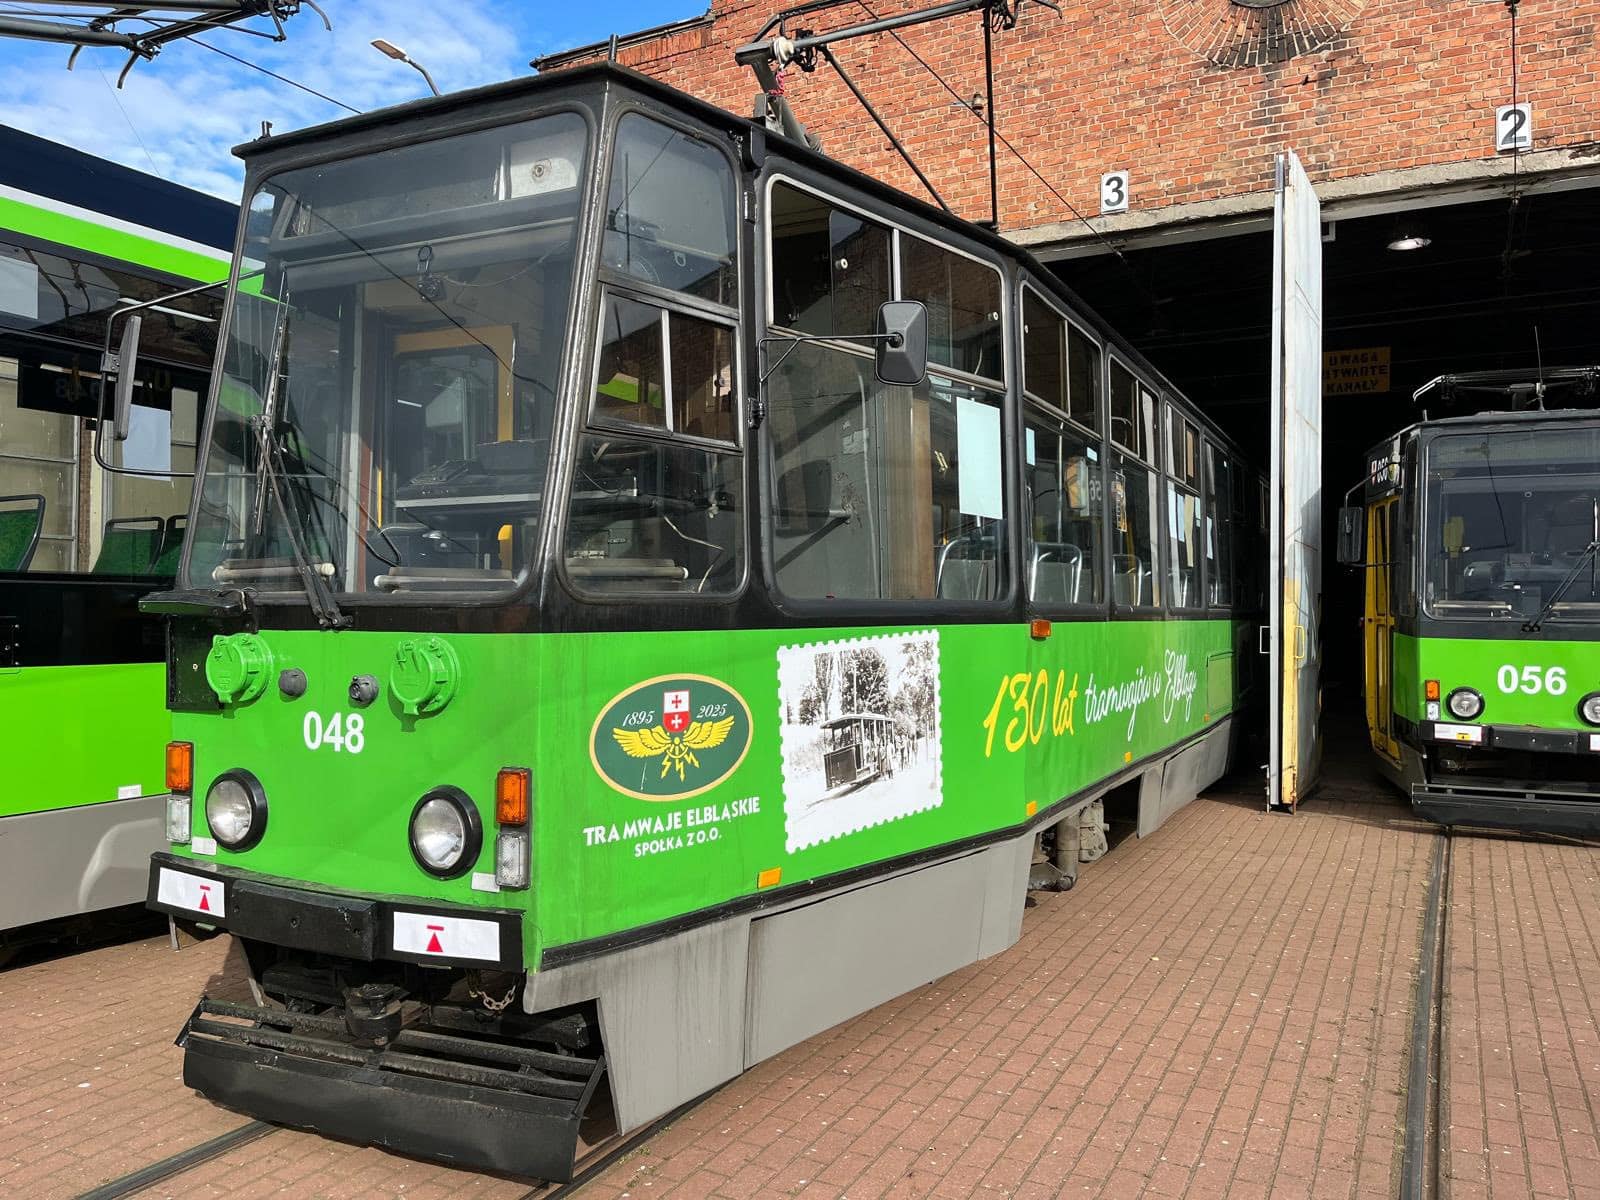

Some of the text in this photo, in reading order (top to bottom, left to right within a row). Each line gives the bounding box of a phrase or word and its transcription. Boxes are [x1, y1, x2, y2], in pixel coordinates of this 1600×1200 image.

[1500, 108, 1528, 146] 2
[1104, 176, 1124, 208] 3
[1496, 664, 1568, 696] 056
[622, 710, 655, 726] 1895
[696, 703, 728, 719] 2025
[983, 668, 1049, 758] 130
[1052, 669, 1079, 737] lat
[1085, 665, 1151, 742] tramwajów
[302, 710, 365, 755] 048
[582, 796, 761, 847] TRAMWAJE ELBLĄSKIE
